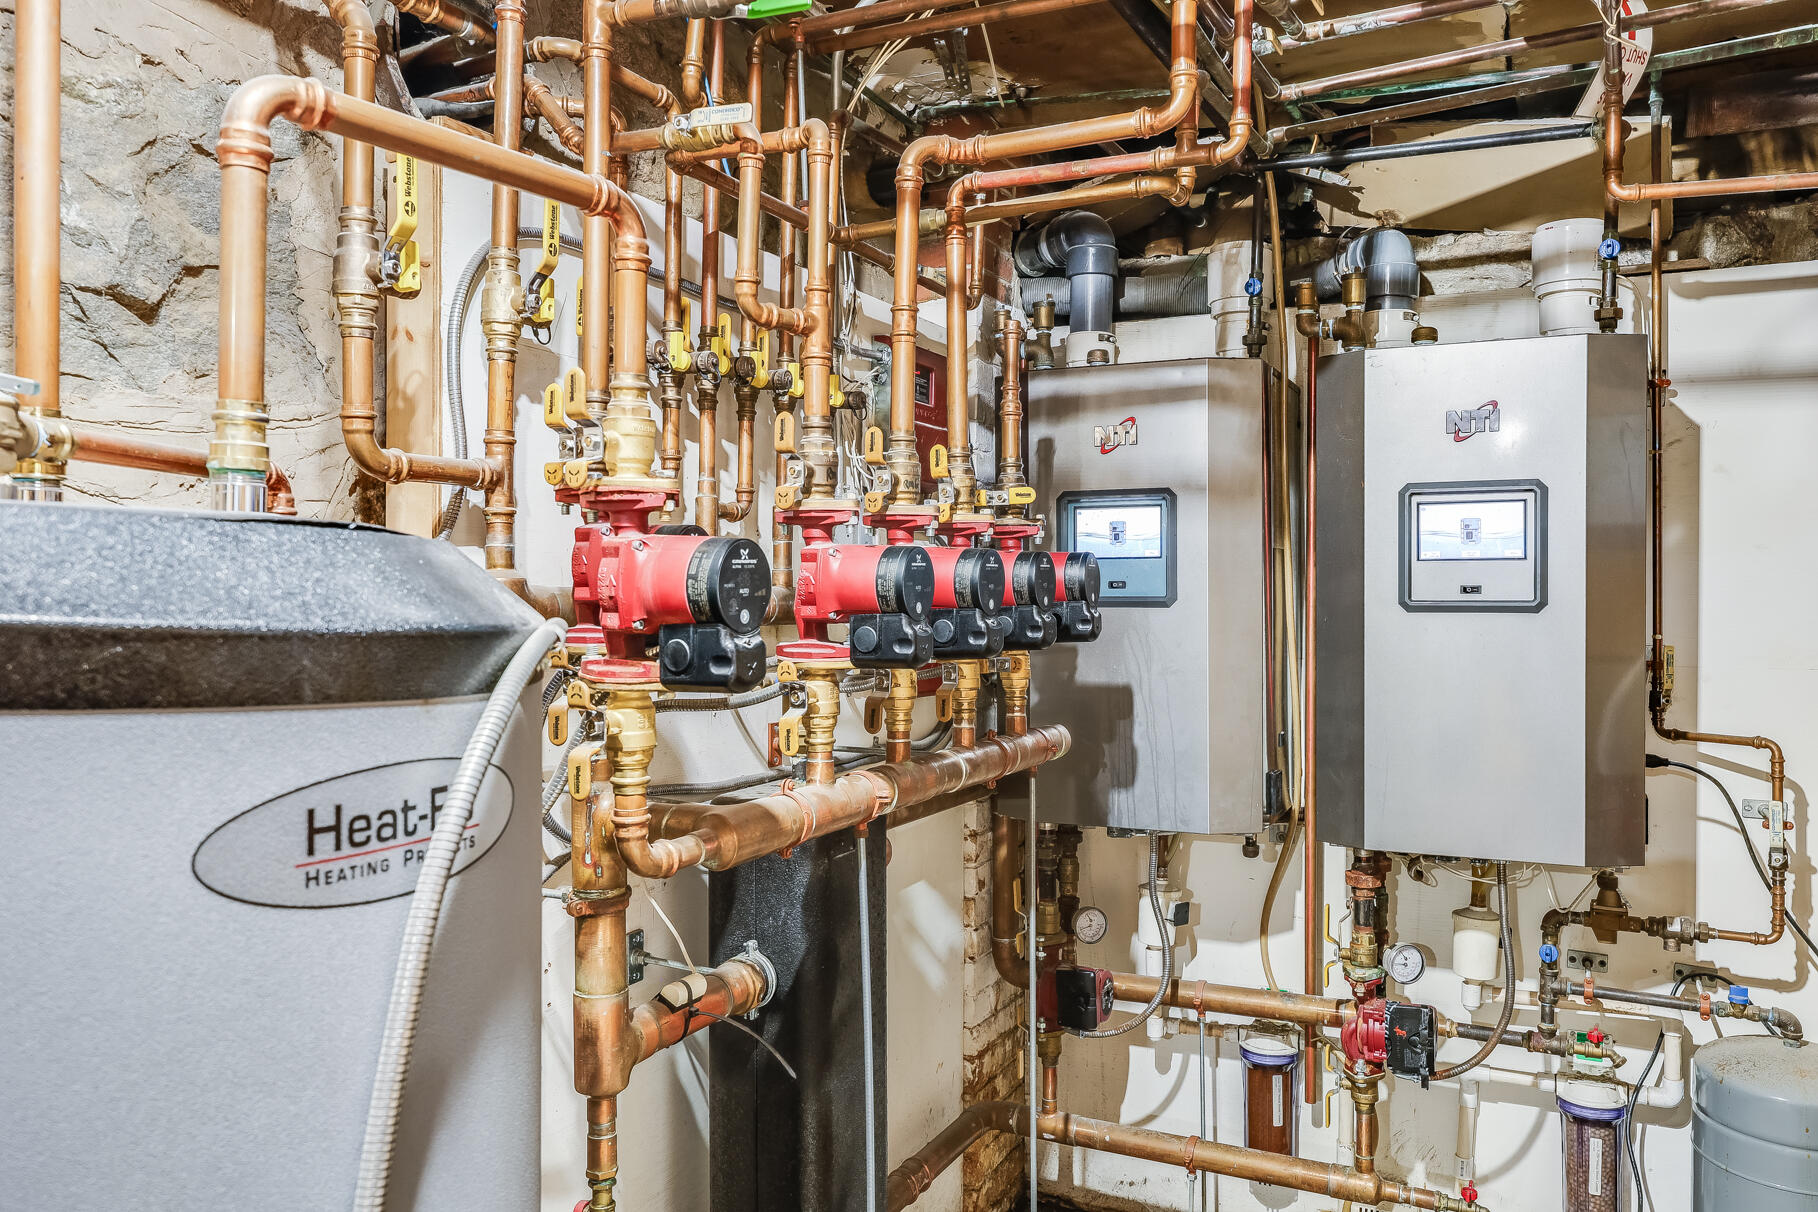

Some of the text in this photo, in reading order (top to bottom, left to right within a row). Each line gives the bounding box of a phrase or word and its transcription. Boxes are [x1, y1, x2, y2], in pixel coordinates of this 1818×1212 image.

[1626, 47, 1648, 65] SHUT
[1446, 408, 1500, 435] NTI
[1094, 424, 1137, 447] NTI
[305, 858, 390, 889] HEATING
